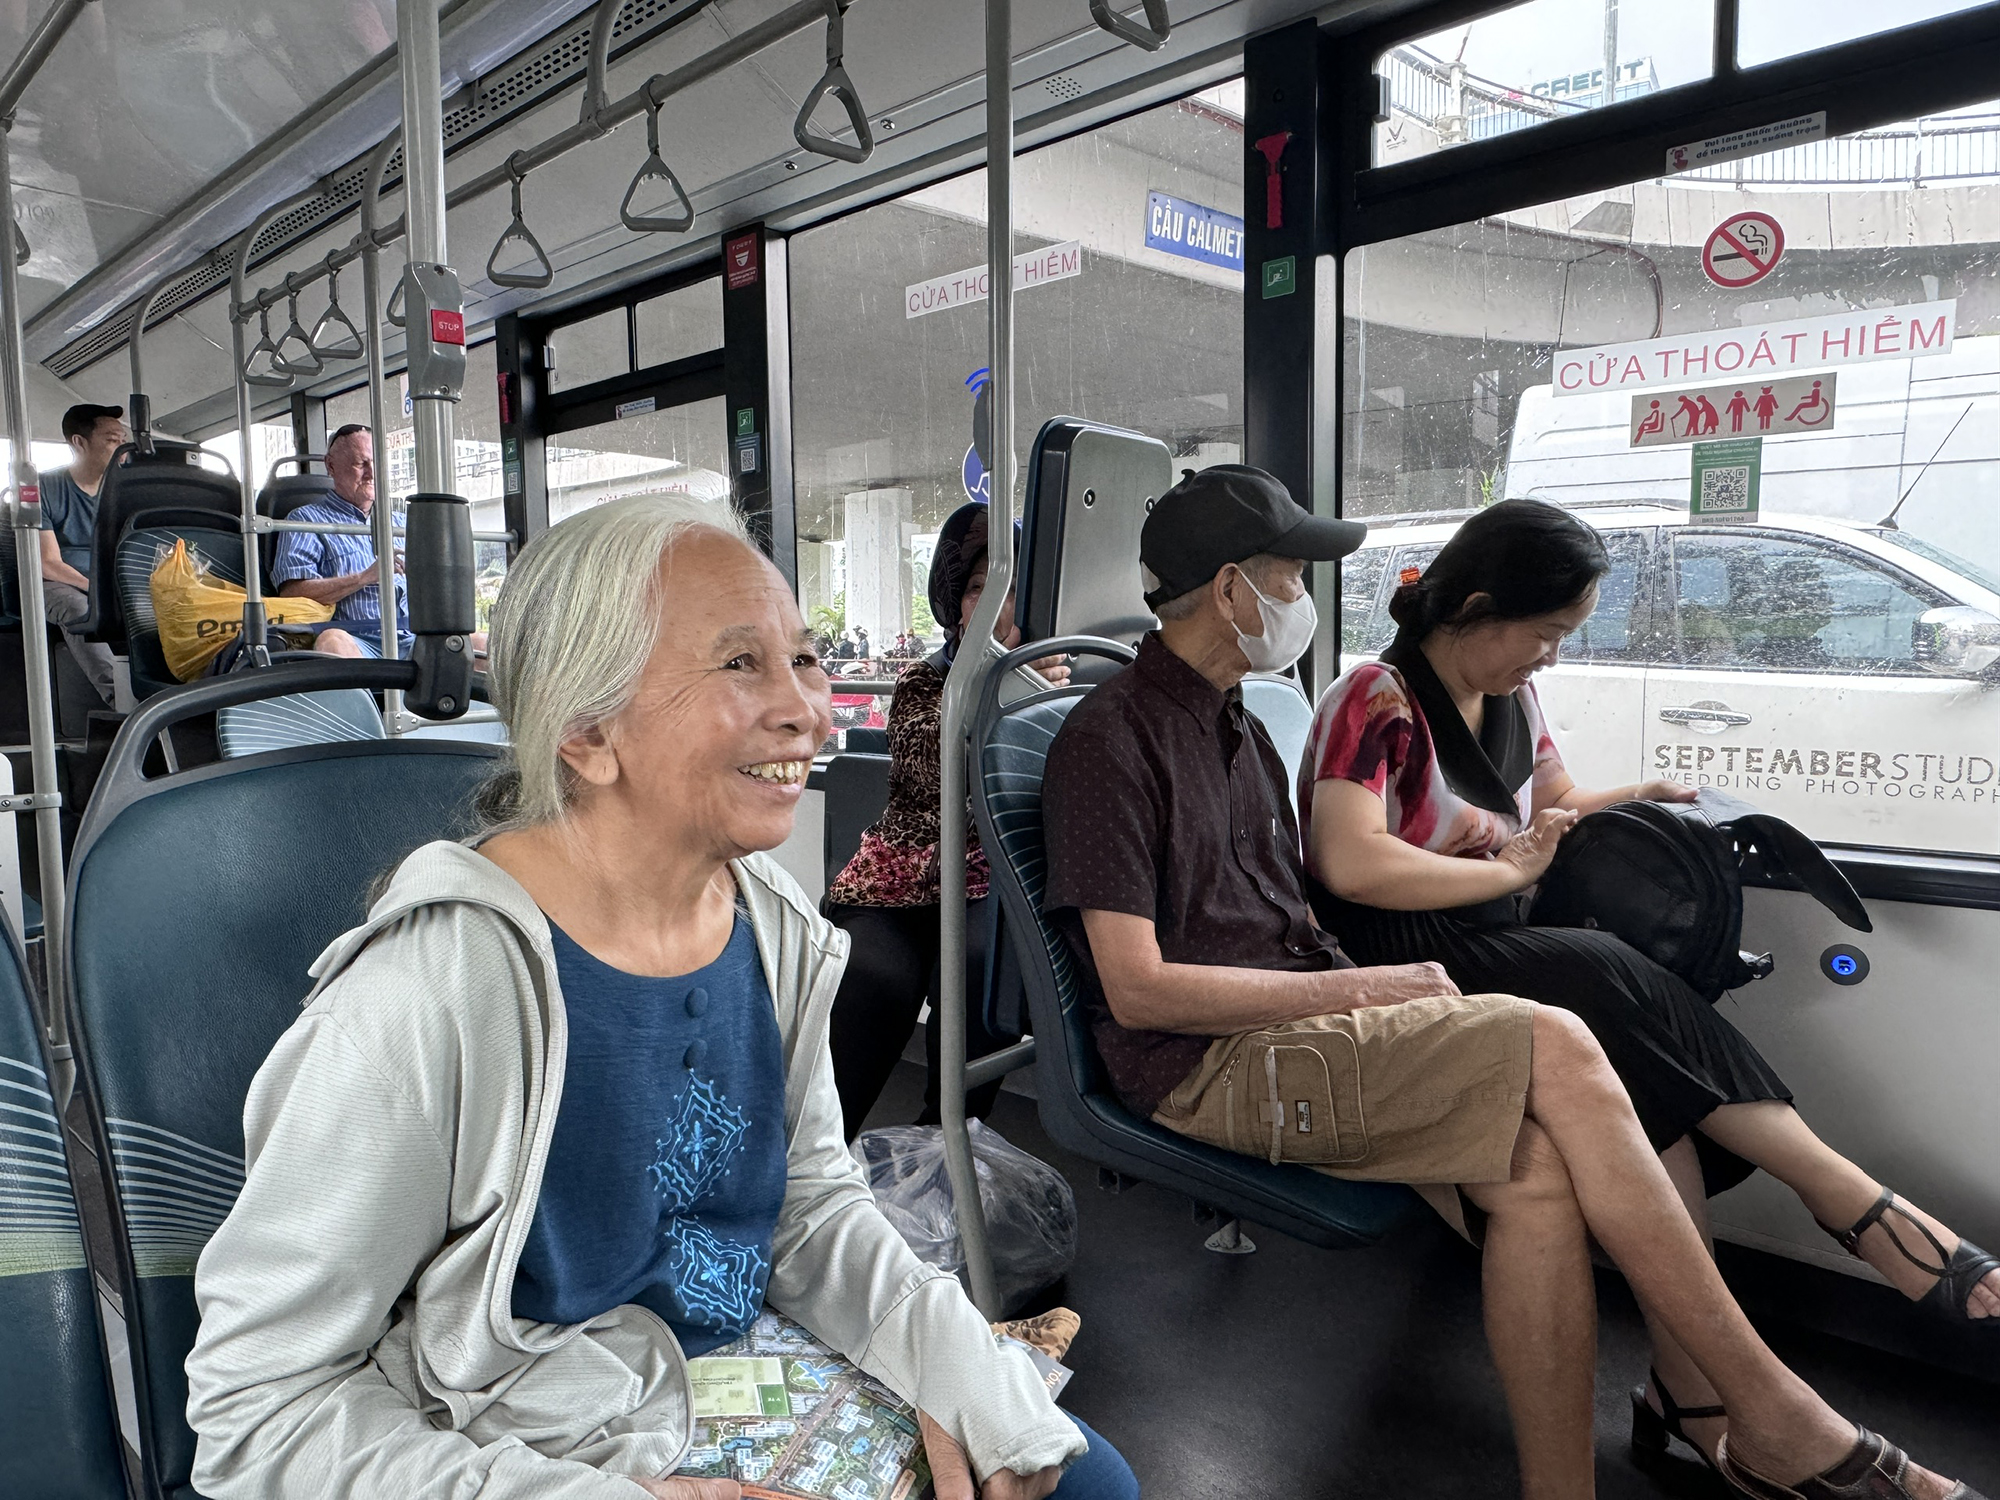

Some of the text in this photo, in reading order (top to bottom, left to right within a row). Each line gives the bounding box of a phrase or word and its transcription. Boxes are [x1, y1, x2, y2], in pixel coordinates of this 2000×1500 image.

[1531, 61, 1643, 98] CREDIT
[1152, 199, 1184, 242] CẦU
[909, 286, 949, 312] CỬA
[1025, 250, 1077, 282] HIỂM
[438, 321, 460, 331] STOP
[1559, 314, 1946, 390] CỬA THOÁT HIỂM
[1662, 771, 1781, 791] WEDDING
